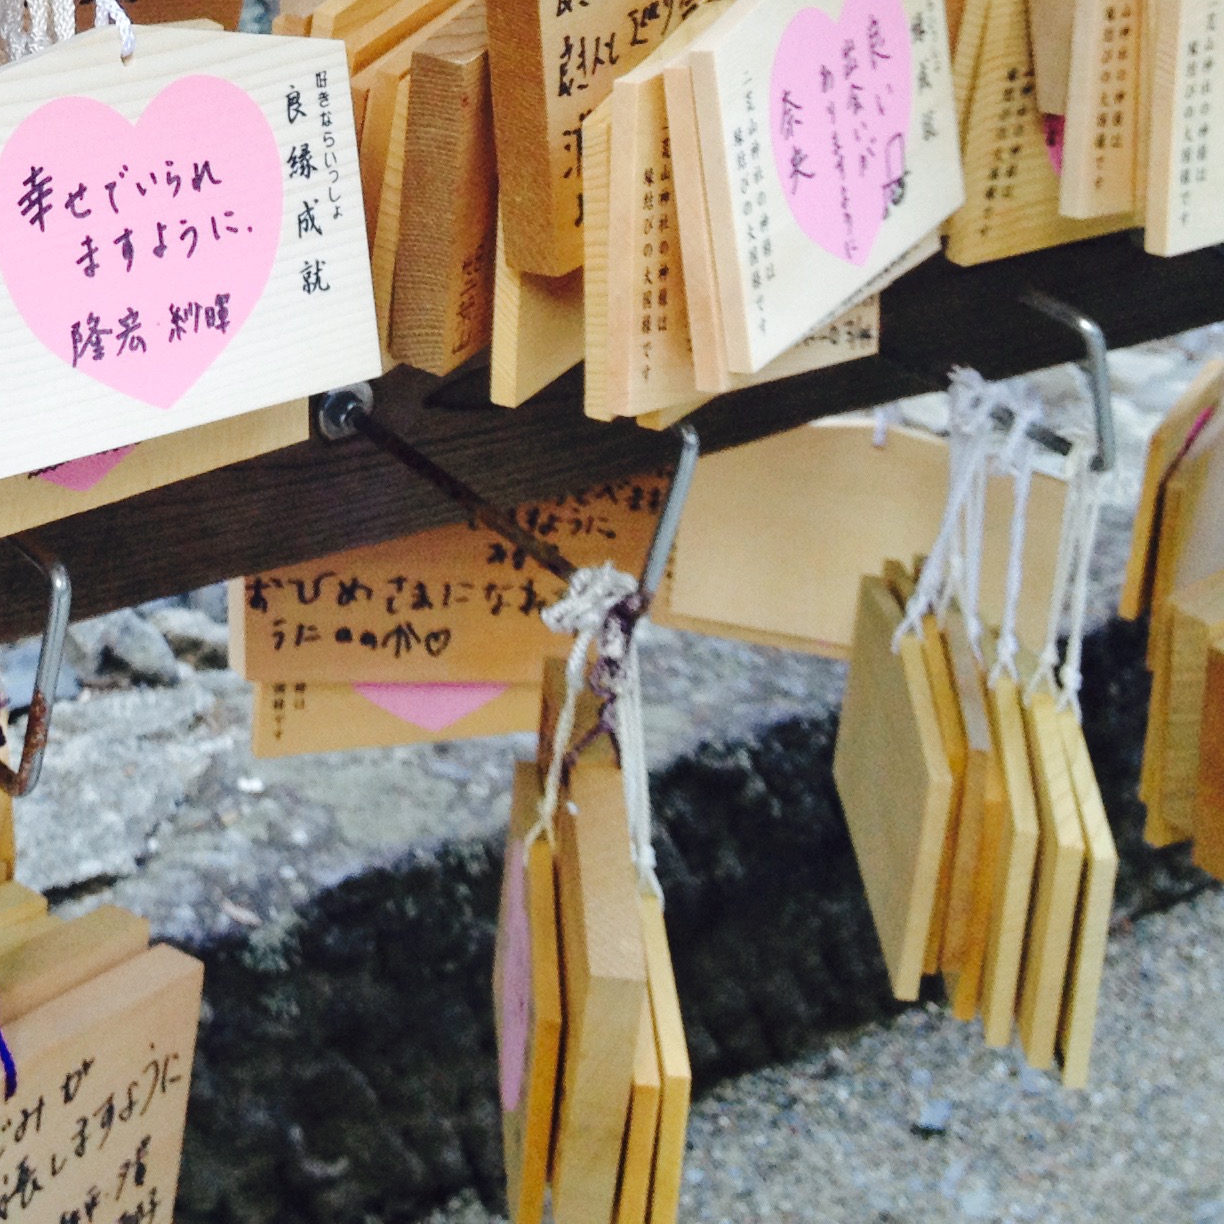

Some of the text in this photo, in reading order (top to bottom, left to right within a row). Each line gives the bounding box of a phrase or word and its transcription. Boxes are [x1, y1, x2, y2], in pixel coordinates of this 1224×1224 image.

[16, 159, 224, 233] 幸せでいられ
[285, 83, 331, 296] 良縁成就
[314, 70, 343, 222] 好きならいっしょ
